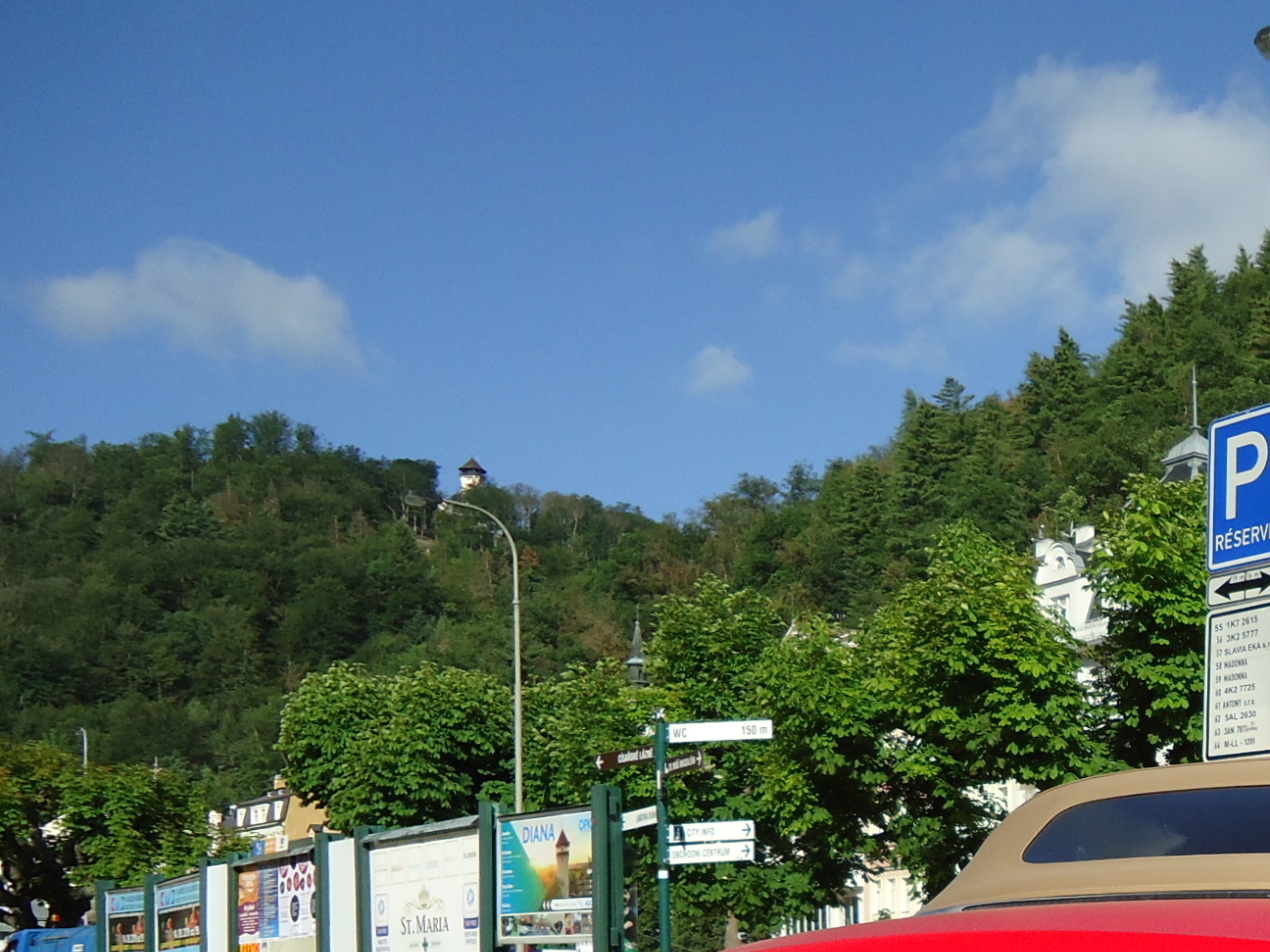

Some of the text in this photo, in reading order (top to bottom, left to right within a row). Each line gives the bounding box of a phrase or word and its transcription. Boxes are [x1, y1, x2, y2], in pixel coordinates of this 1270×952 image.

[1225, 431, 1269, 520] P
[1214, 615, 1258, 632] 55 1K7 2615
[1226, 632, 1240, 642] 3K2
[1242, 628, 1258, 639] 5777
[1224, 645, 1246, 656] SLAVIA
[1248, 642, 1261, 652] EKA
[1224, 658, 1248, 669] MADONNA
[1224, 672, 1248, 682] MADONNA
[1224, 686, 1238, 694] 4K2
[1240, 683, 1256, 692] 7725
[1222, 699, 1242, 709] ANTONY
[1240, 710, 1256, 720] 2630
[673, 728, 687, 738] WC
[741, 725, 768, 735] 150 m
[522, 823, 556, 844] DIANA
[687, 828, 714, 836] CITY INFO
[702, 848, 730, 857] CENTRUM
